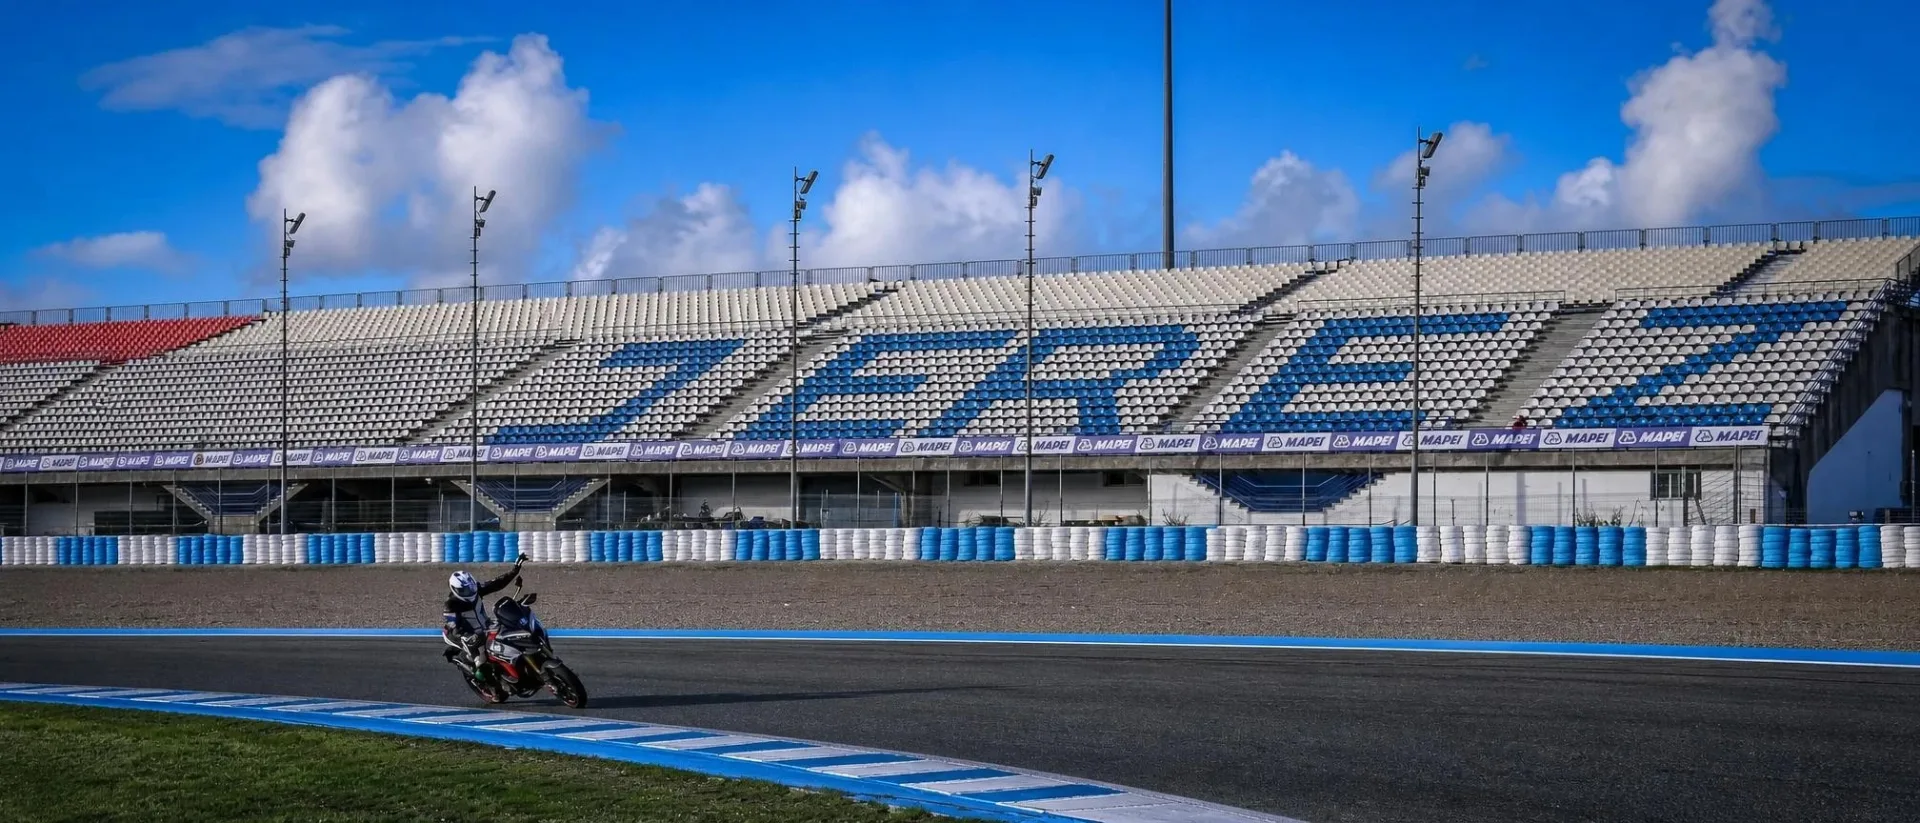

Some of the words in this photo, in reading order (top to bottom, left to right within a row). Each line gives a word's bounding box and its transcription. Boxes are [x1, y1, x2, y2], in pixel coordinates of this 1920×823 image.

[483, 301, 1850, 440] JEREZ
[1352, 436, 1393, 446] MAPEI
[1420, 435, 1463, 445] MAPEI
[1490, 434, 1536, 444] MAPEI
[1565, 432, 1609, 443] MAPEI
[1639, 431, 1687, 442] MAPEI
[1716, 431, 1762, 441] MAPEI
[917, 442, 952, 451] MAPEI
[974, 441, 1010, 451] MAPEI
[1034, 440, 1070, 450] MAPEI
[1094, 440, 1133, 449] MAPEI
[1157, 439, 1195, 448] MAPEI
[1220, 438, 1260, 448] MAPEI
[1285, 437, 1326, 446] MAPEI
[502, 447, 531, 457] MAPEI
[547, 446, 578, 456] MAPEI
[596, 446, 625, 455] MAPEI
[644, 445, 675, 455] MAPEI
[692, 444, 724, 455] MAPEI
[746, 443, 781, 453] MAPEI
[801, 443, 834, 453] MAPEI
[858, 442, 895, 452] MAPEI
[205, 454, 230, 463] MAPEI
[324, 452, 351, 461] MAPEI
[368, 451, 394, 460] MAPEI
[411, 450, 439, 459] MAPEI
